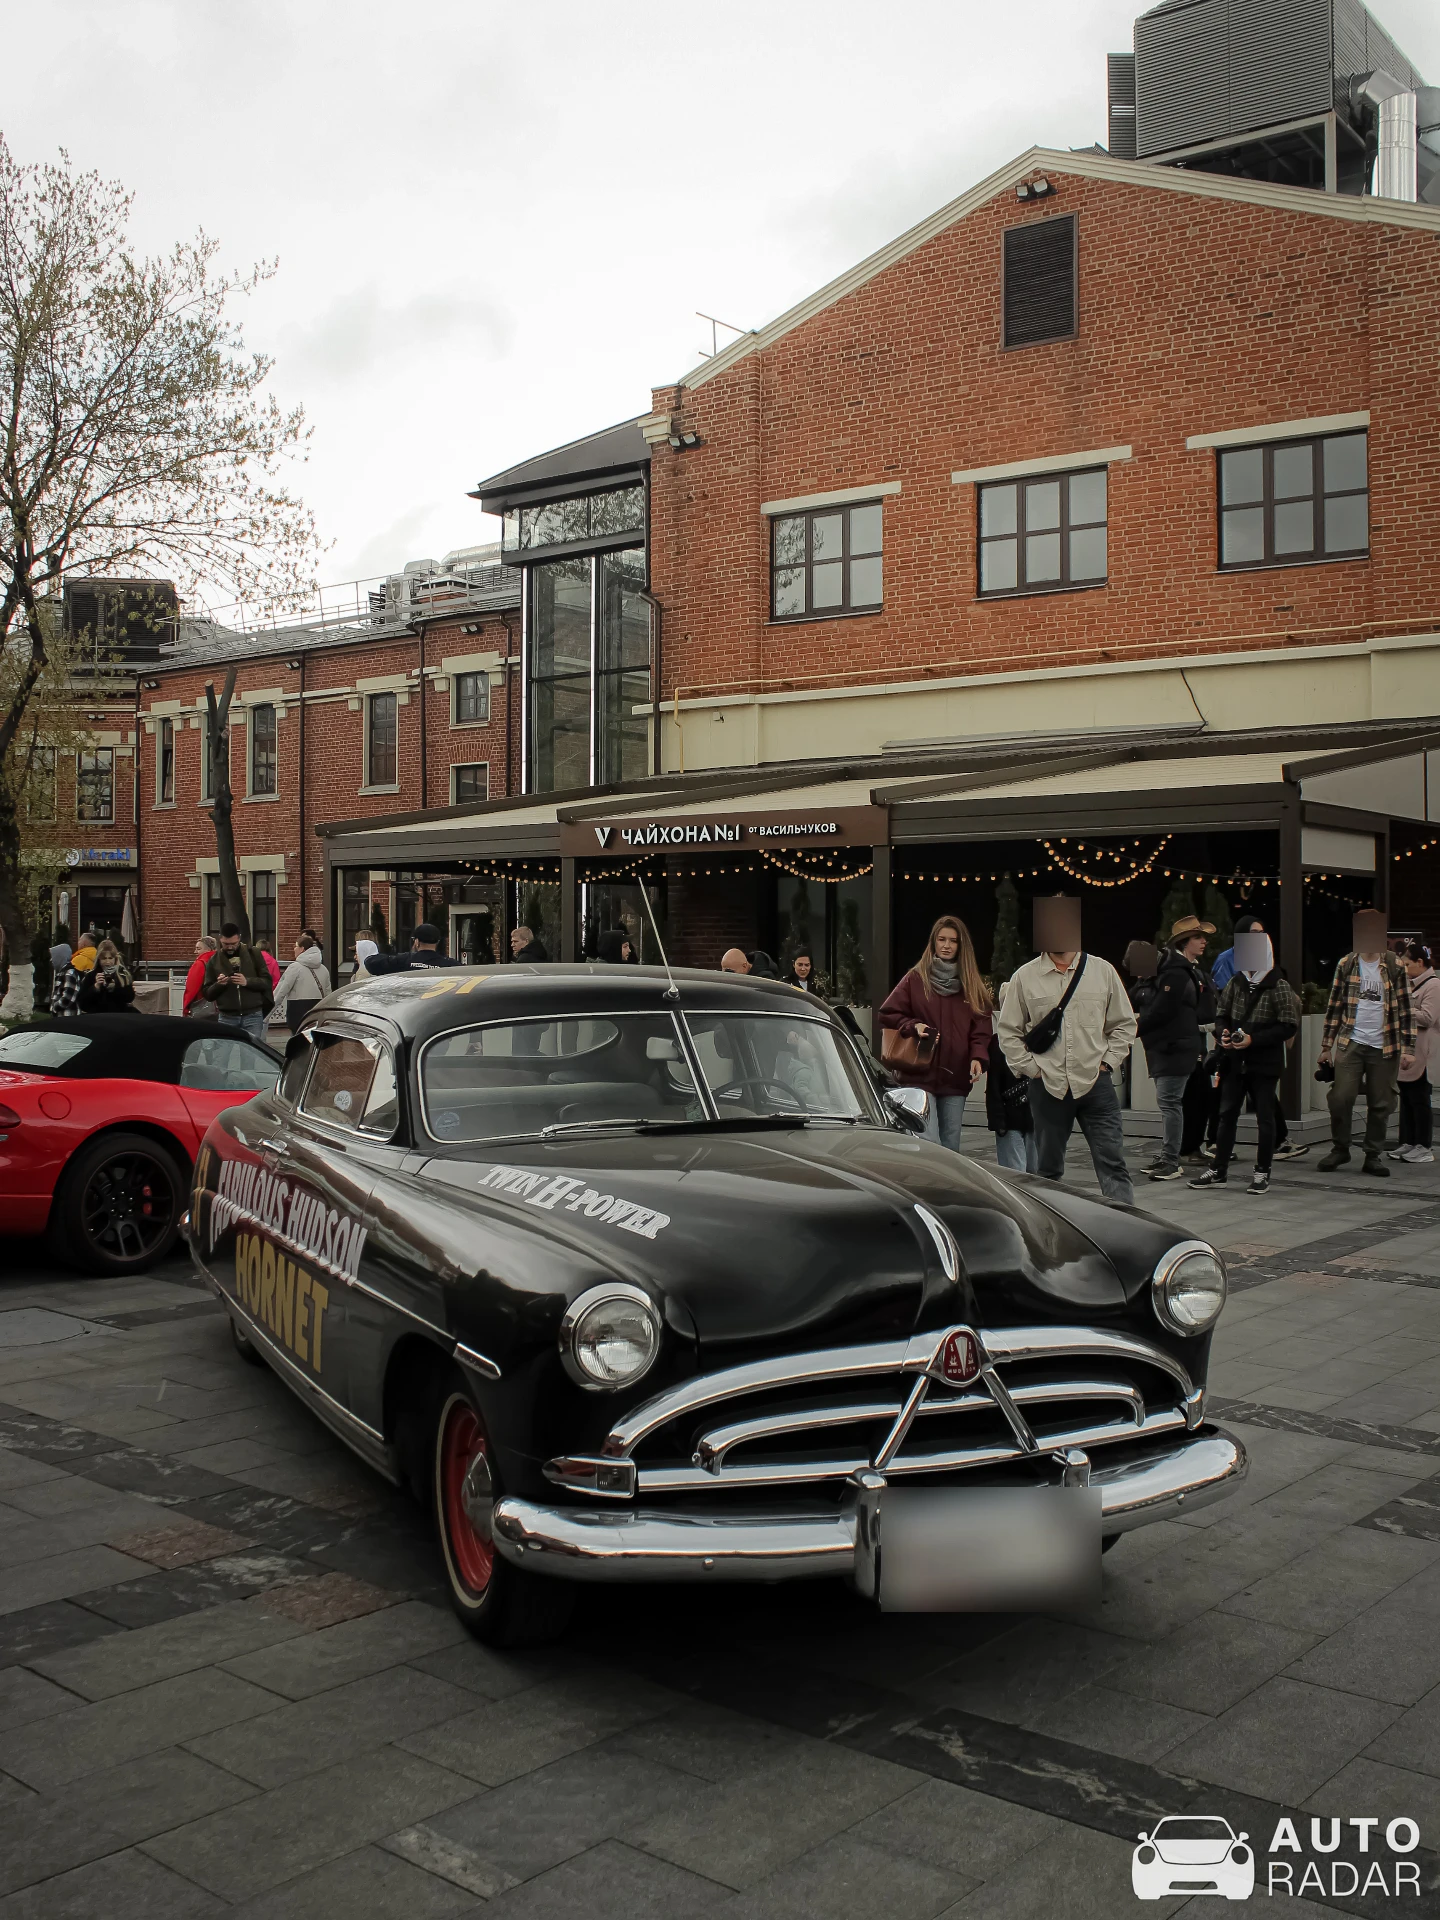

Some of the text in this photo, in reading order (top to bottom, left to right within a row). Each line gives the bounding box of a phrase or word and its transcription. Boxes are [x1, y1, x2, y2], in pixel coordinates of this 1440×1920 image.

[759, 822, 837, 836] ВАСИЛЬЧУКОВ
[420, 975, 489, 1000] 51
[210, 1160, 290, 1253] FABULOUS
[286, 1187, 368, 1286] HUDSON
[477, 1165, 672, 1240] TWIN H-POWER
[235, 1232, 329, 1374] HORNET
